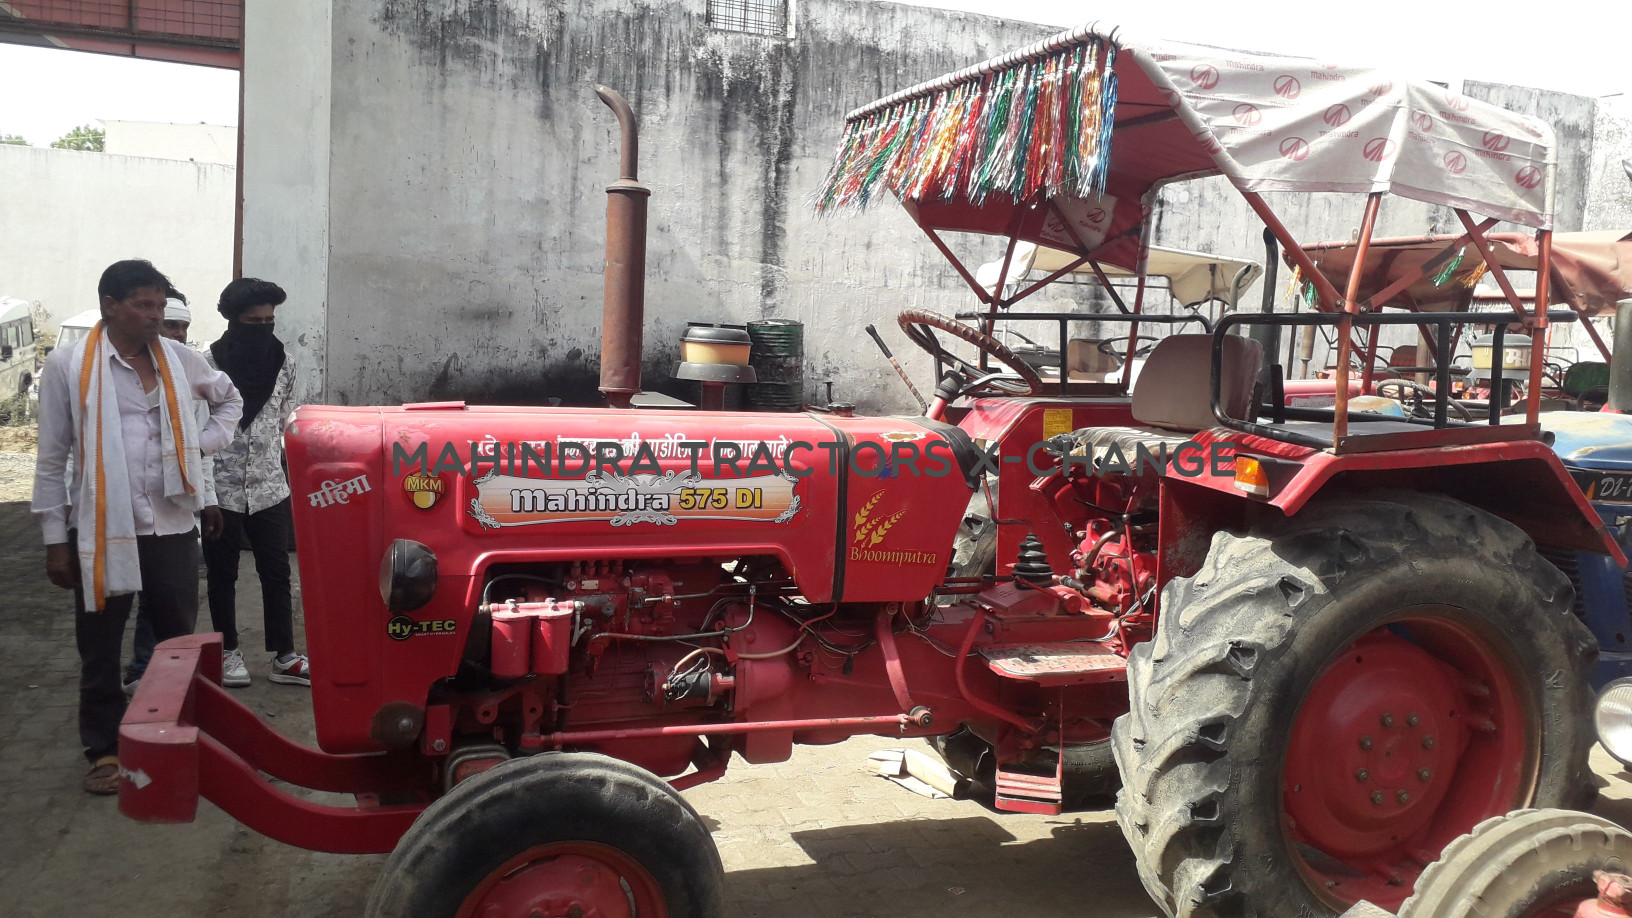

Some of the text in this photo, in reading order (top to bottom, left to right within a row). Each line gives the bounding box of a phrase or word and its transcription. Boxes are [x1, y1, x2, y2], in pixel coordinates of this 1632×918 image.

[307, 474, 372, 509] महिमा
[406, 476, 442, 492] MKM
[510, 488, 763, 512] Mahindra 575 DI
[850, 546, 937, 568] Bhoomiputra
[388, 619, 456, 636] Hy-TEC
